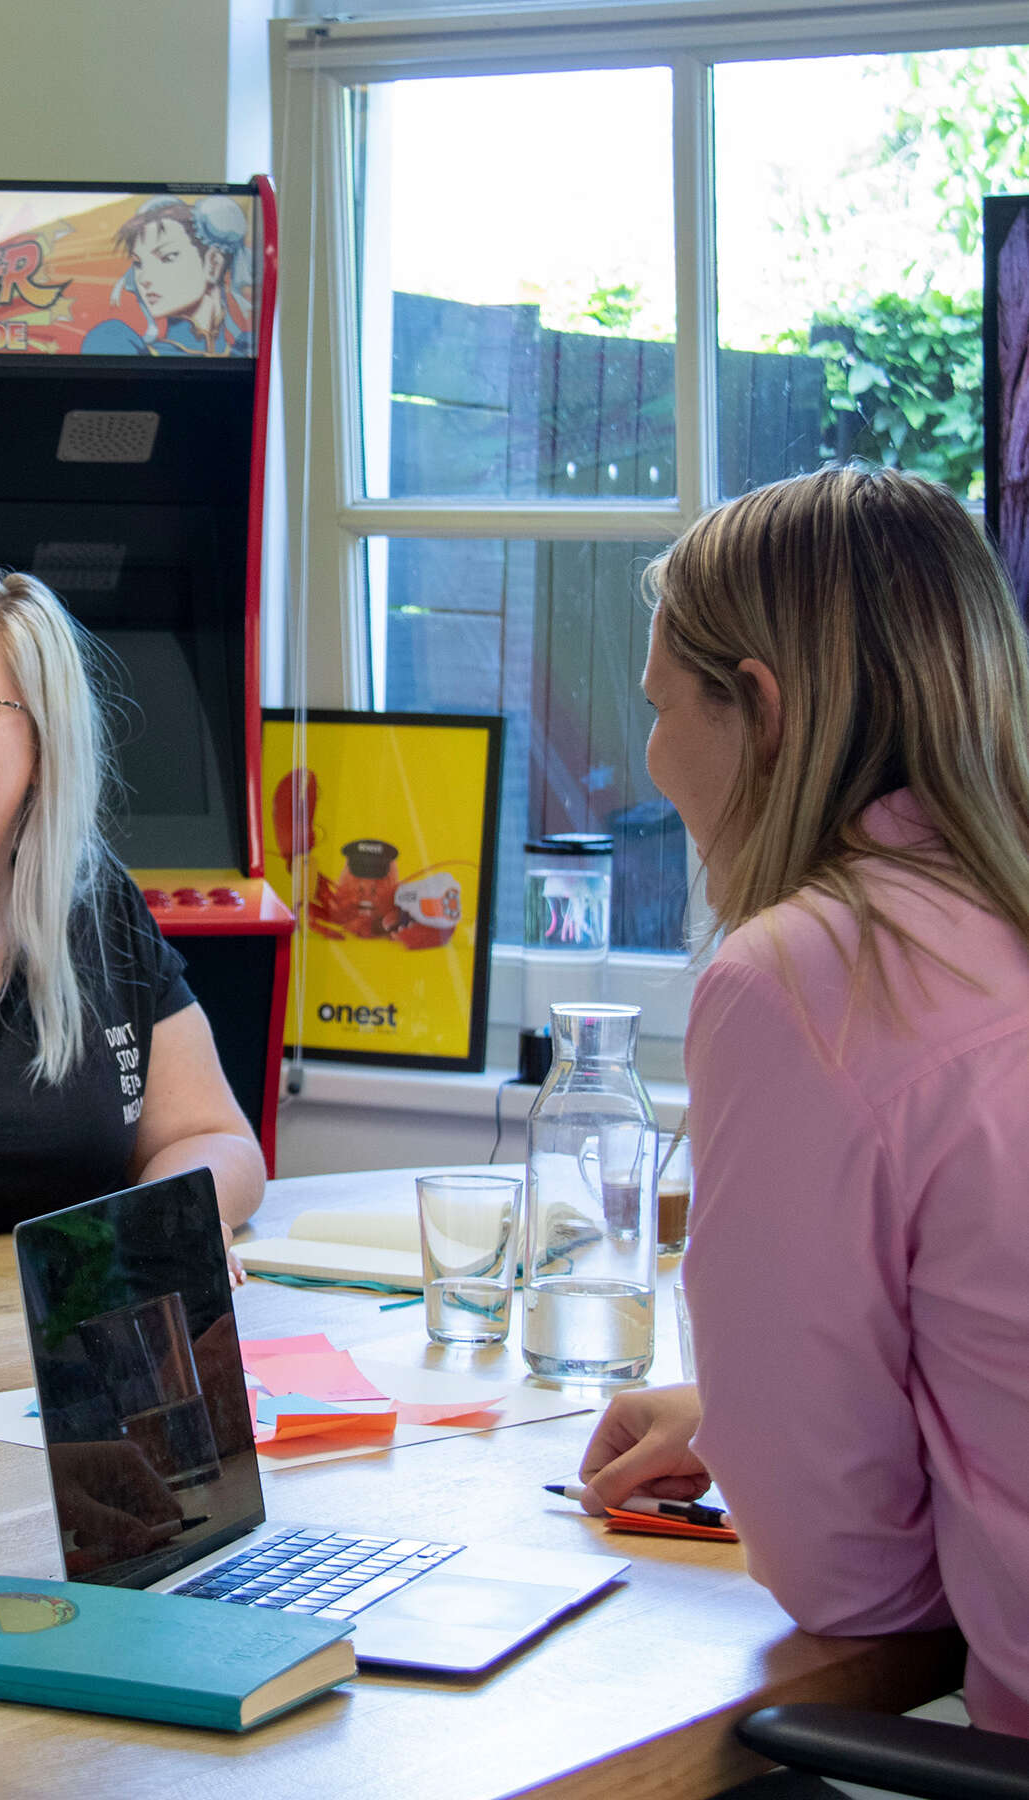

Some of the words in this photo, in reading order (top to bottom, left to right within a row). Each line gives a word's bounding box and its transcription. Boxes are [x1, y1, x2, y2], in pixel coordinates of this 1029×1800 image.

[318, 1003, 398, 1028] onest
[105, 1022, 136, 1048] DON'T
[116, 1047, 140, 1072] STOP
